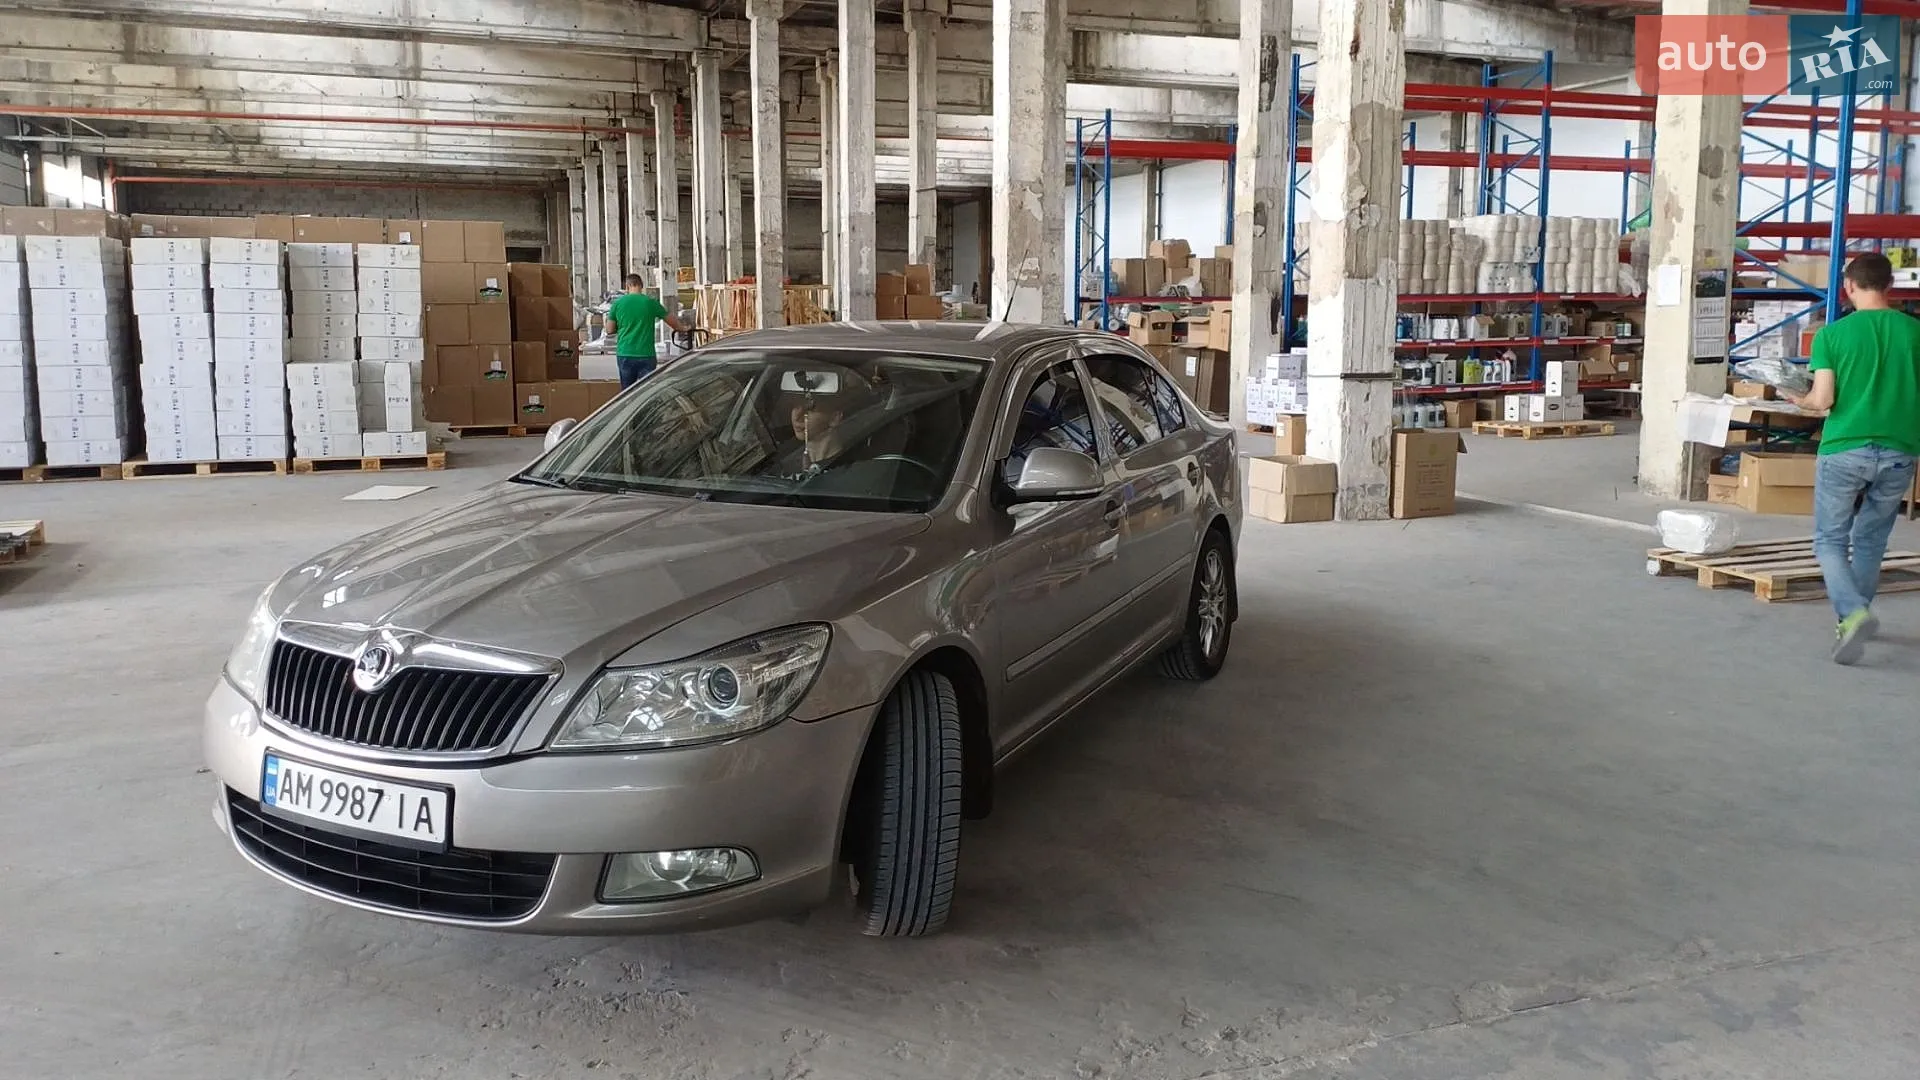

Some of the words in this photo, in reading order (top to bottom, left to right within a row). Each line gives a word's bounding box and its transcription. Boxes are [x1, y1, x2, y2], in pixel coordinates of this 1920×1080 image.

[279, 768, 313, 809] AM
[319, 779, 385, 823] 9987
[398, 793, 434, 834] IA
